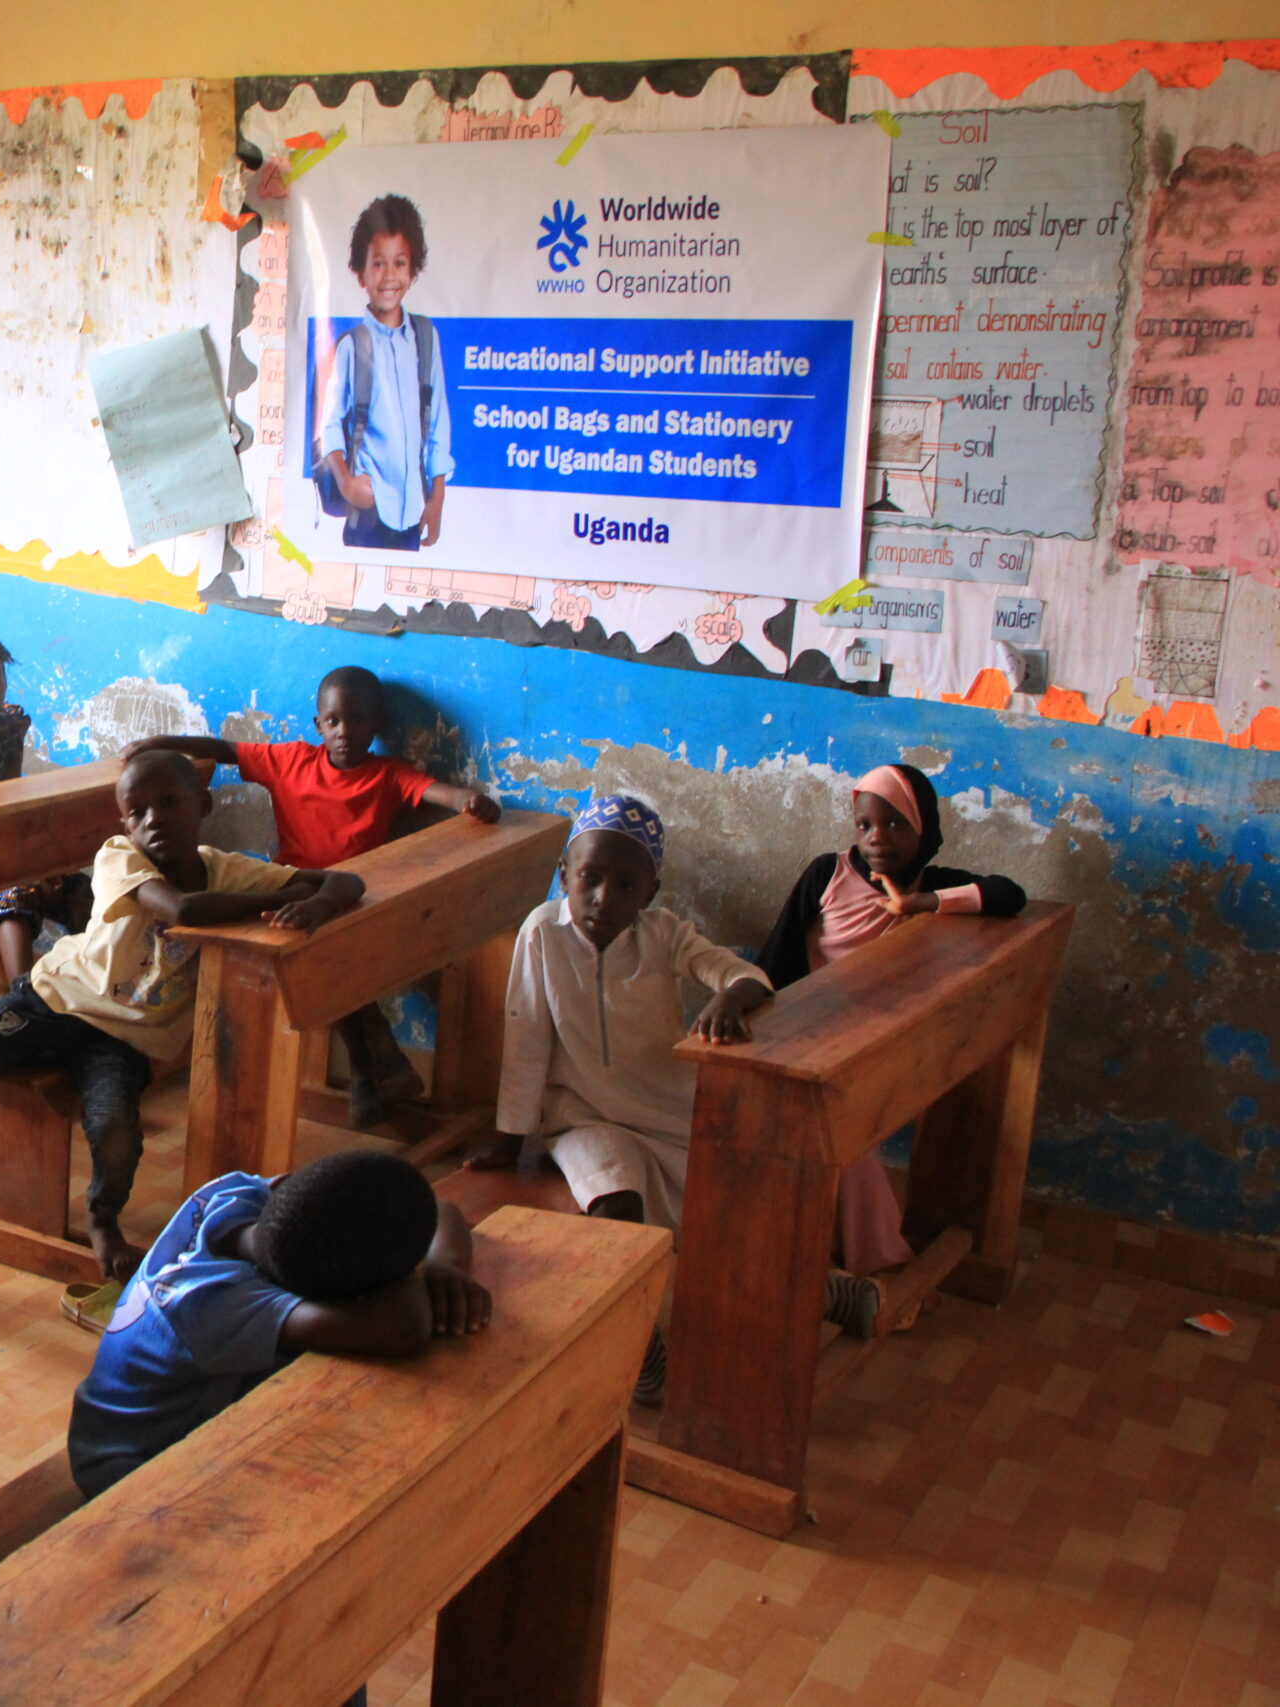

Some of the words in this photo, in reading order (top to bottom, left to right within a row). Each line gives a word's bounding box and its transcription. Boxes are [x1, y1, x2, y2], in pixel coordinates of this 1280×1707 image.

[545, 107, 556, 137] B
[939, 111, 988, 144] Soil
[925, 161, 939, 192] is
[954, 157, 997, 192] soil?
[600, 195, 720, 222] Worldwide
[902, 207, 915, 238] is
[921, 206, 948, 238] the
[955, 208, 983, 252] top
[992, 205, 1037, 237] most
[1040, 202, 1087, 250] layer
[1097, 201, 1123, 235] of
[597, 233, 740, 259] Humanitarian
[536, 279, 585, 293] WWHO
[596, 269, 732, 298] Organization
[1145, 251, 1187, 288] Soil
[1187, 250, 1252, 303] profile
[881, 299, 965, 348] periment
[978, 299, 1107, 348] demonstrating
[464, 346, 595, 373] Educational
[601, 348, 694, 377] Support
[700, 350, 810, 377] Initiative
[886, 348, 911, 380] soil
[927, 348, 983, 380] contains
[960, 384, 1012, 411] water
[1023, 381, 1094, 426] droplets
[1180, 373, 1209, 422] top
[1225, 373, 1244, 406] to
[473, 404, 549, 431] School
[555, 408, 610, 437] Bags
[615, 409, 659, 434] and
[664, 410, 793, 443] Stationery
[963, 426, 996, 457] soil
[506, 443, 539, 468] for
[544, 446, 643, 476] Ugandan
[648, 451, 757, 478] Students
[964, 472, 1008, 506] heat
[573, 513, 670, 545] Uganda
[969, 538, 991, 568] of
[998, 540, 1028, 571] soil
[426, 587, 440, 597] 200
[449, 590, 464, 601] 300
[558, 592, 586, 619] key
[702, 616, 739, 638] scale
